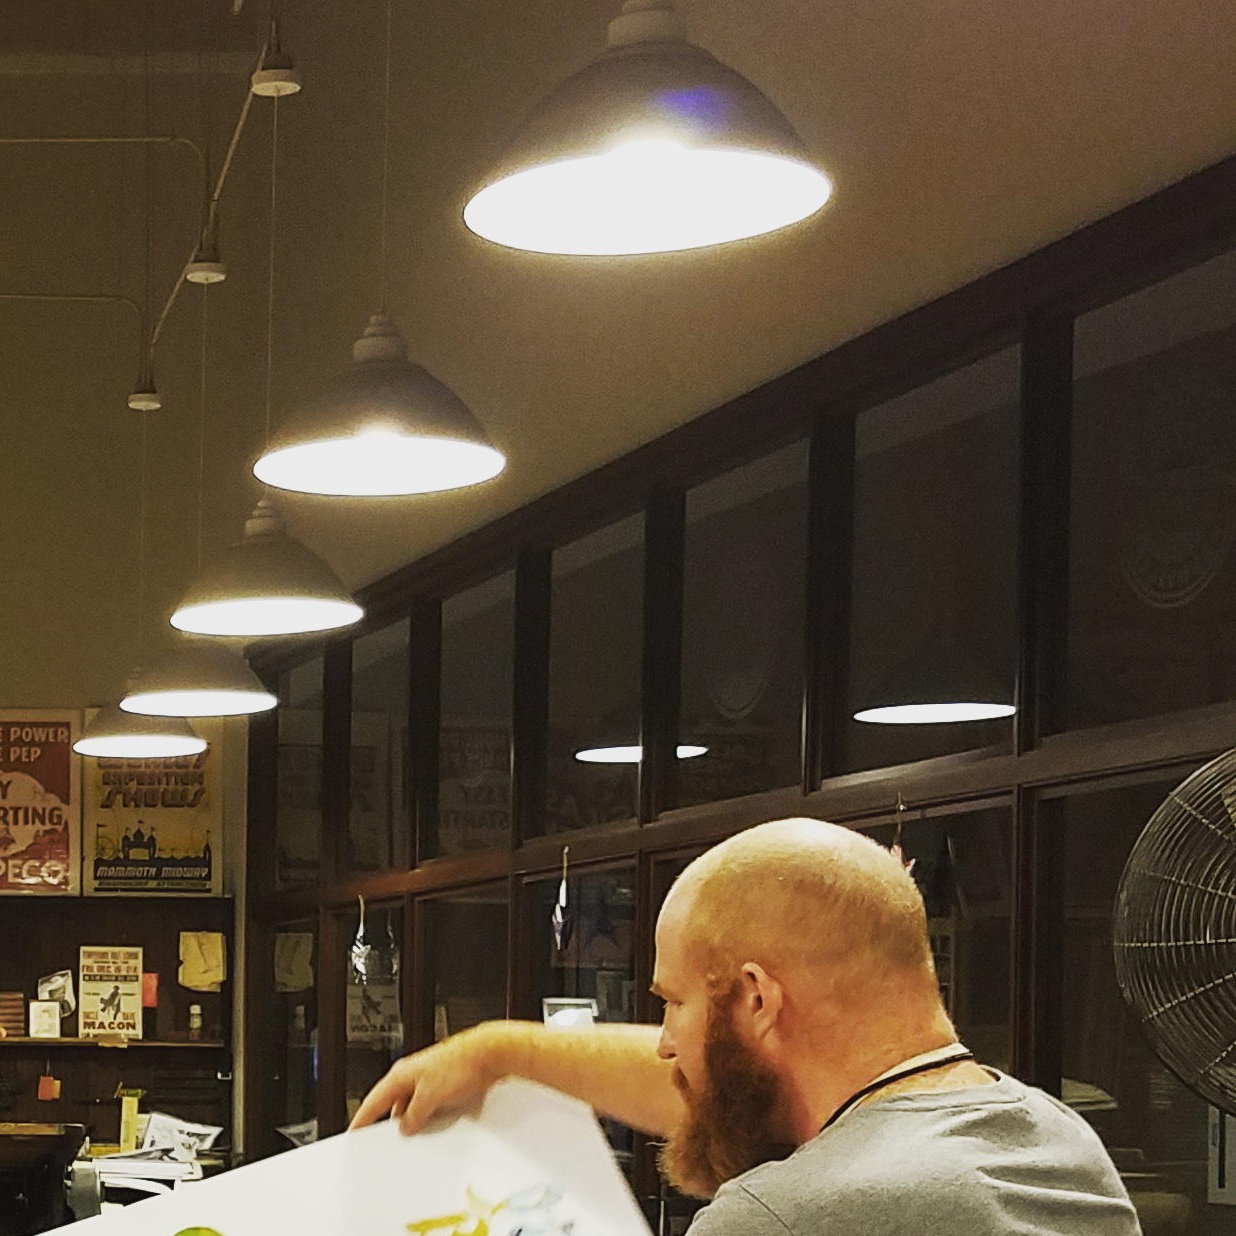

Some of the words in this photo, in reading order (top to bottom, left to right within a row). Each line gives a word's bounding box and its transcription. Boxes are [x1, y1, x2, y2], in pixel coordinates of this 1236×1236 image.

[10, 727, 69, 743] POWER
[10, 747, 41, 762] PEP
[83, 1021, 136, 1030] MACON
